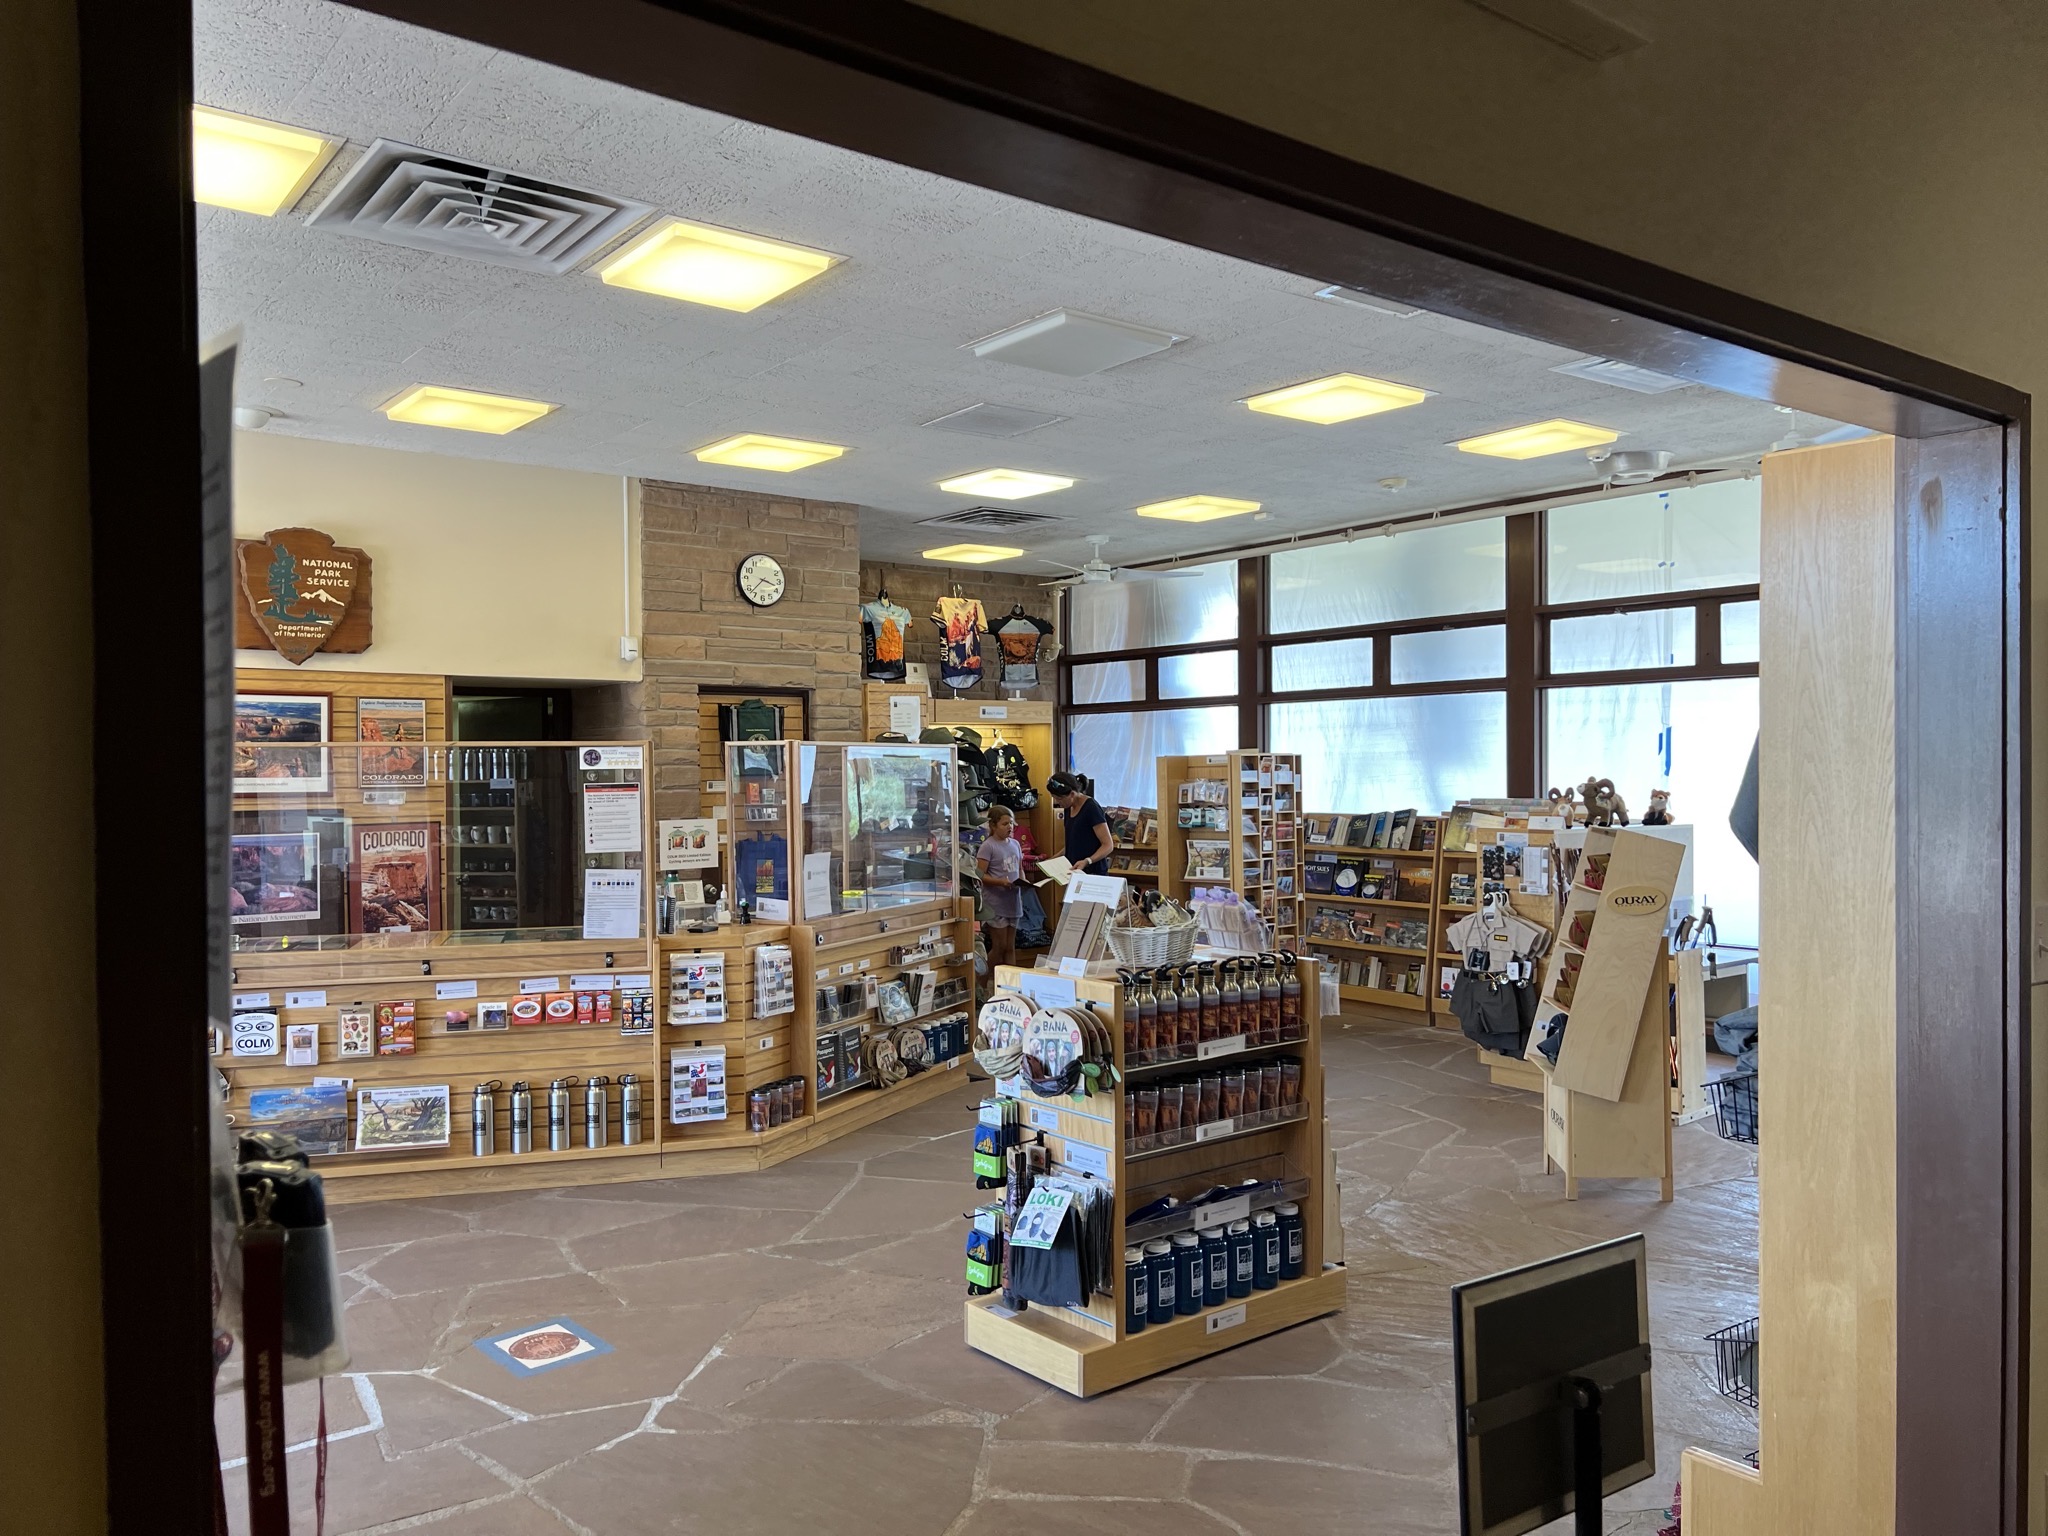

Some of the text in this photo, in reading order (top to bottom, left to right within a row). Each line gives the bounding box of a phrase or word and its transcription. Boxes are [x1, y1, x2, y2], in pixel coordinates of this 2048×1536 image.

[302, 559, 353, 569] NATIONAL
[314, 569, 341, 577] PARK
[306, 577, 350, 587] SERVICE
[278, 624, 322, 632] Department
[940, 637, 949, 662] COLM
[363, 830, 425, 851] COLORADO
[1615, 895, 1658, 905] OURAY
[1000, 1003, 1022, 1017] BANA
[1042, 1021, 1067, 1032] BANA
[238, 1039, 271, 1048] COLM
[1029, 1193, 1065, 1207] LOKI
